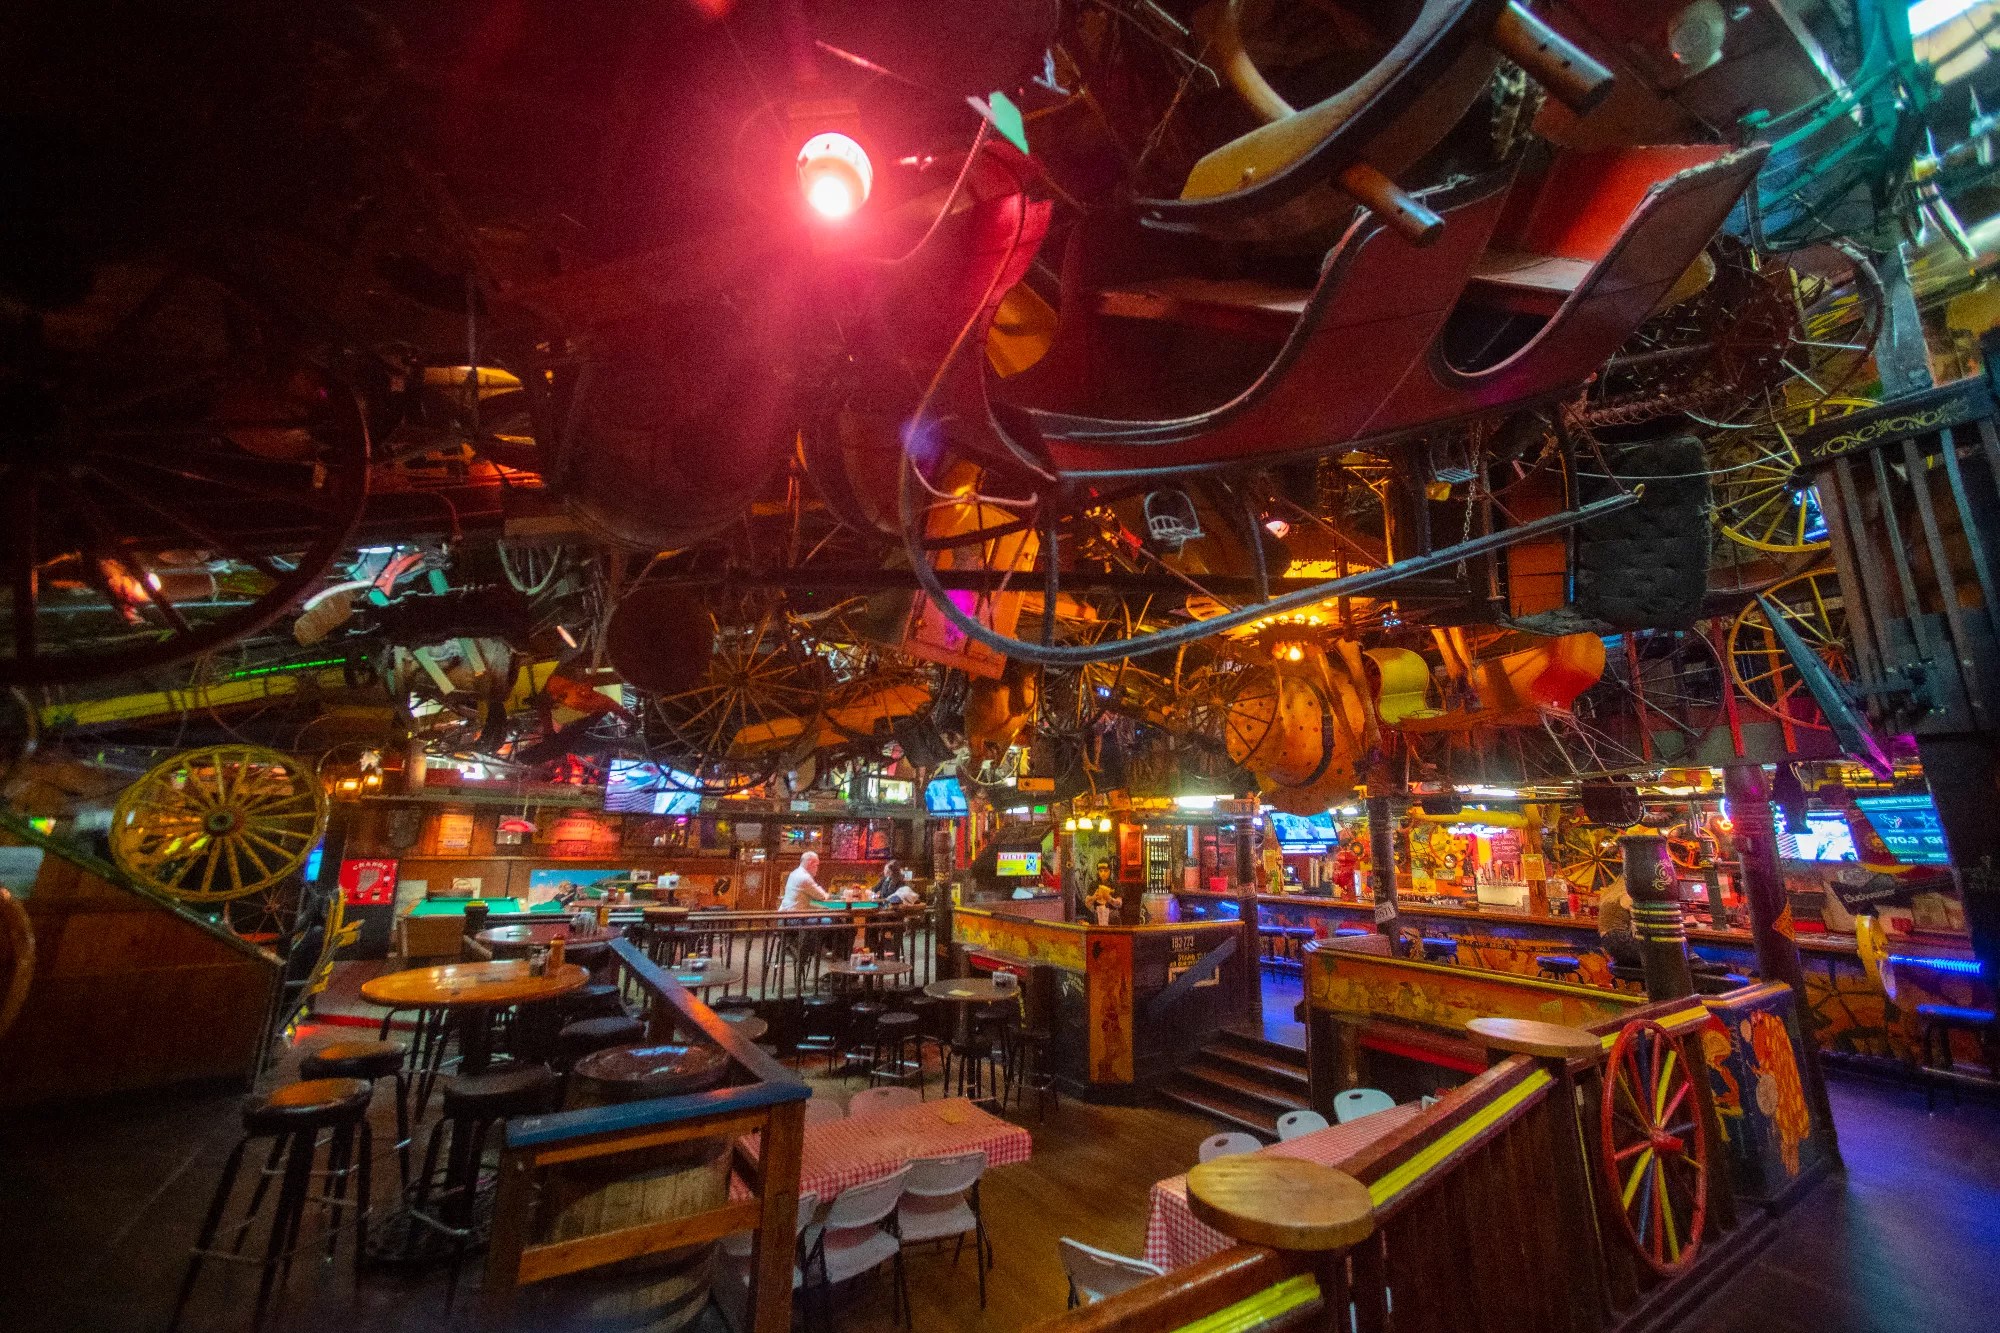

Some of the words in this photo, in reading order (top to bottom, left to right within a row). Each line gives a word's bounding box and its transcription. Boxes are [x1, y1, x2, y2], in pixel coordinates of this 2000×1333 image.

[1885, 836, 1919, 844] 170.3
[352, 862, 388, 870] CHANGE
[1843, 888, 1896, 903] Budweiser
